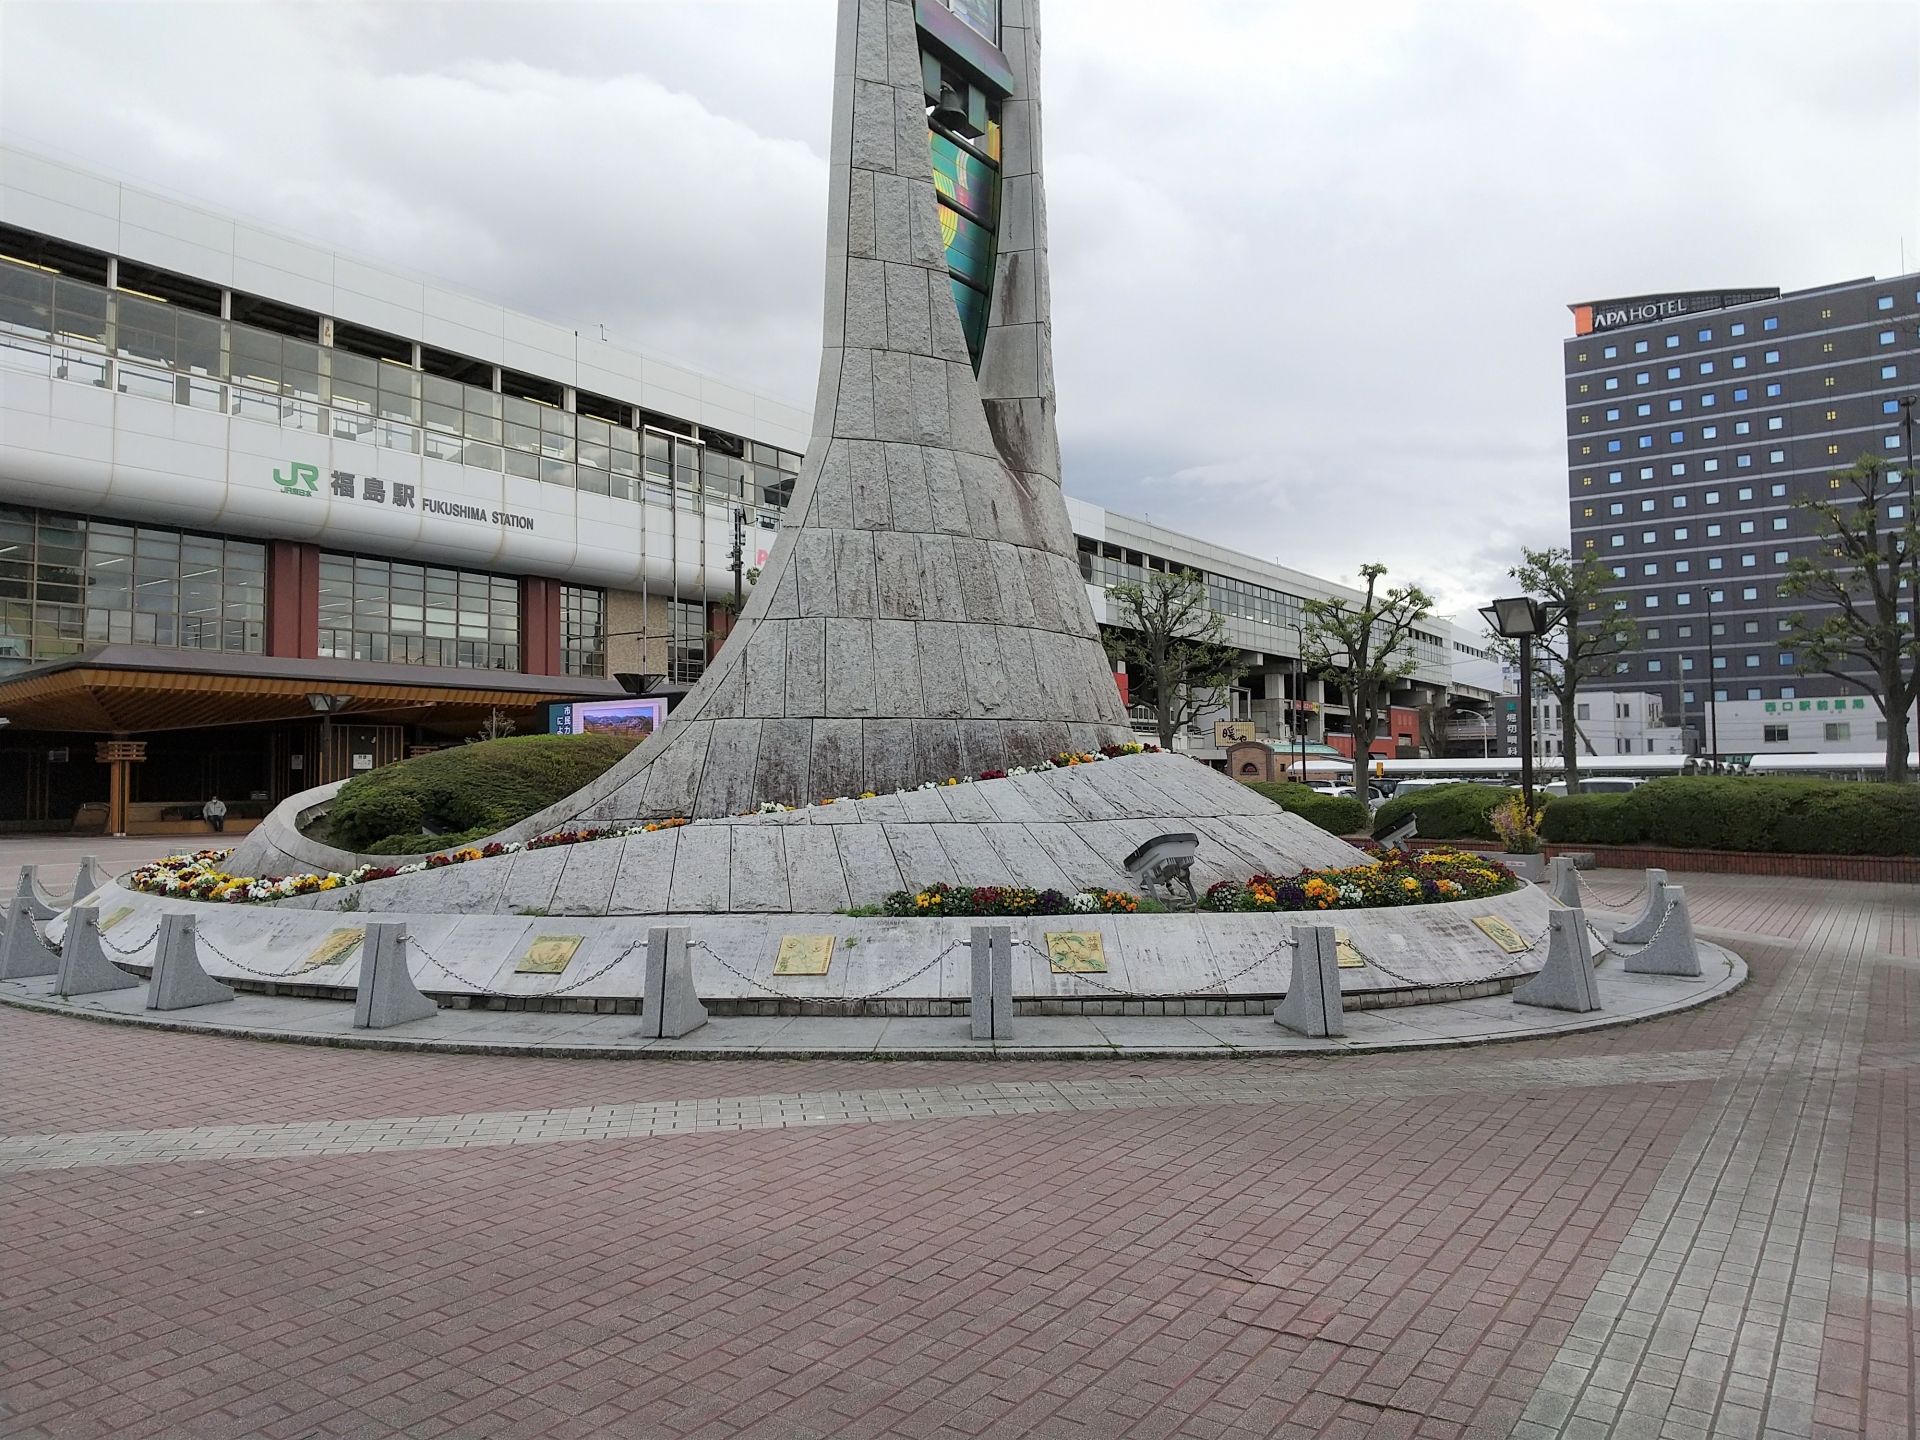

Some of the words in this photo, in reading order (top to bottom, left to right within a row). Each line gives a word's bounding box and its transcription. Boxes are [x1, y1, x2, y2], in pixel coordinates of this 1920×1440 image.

[1594, 309, 1628, 328] APA
[1630, 299, 1687, 321] HOTEL
[273, 461, 319, 491] JR
[280, 486, 312, 497] JR東日本
[331, 470, 415, 508] 福島駅
[422, 497, 487, 522] FUKUSHIMA
[491, 511, 534, 530] STATION
[1506, 714, 1518, 756] 堀切眼科
